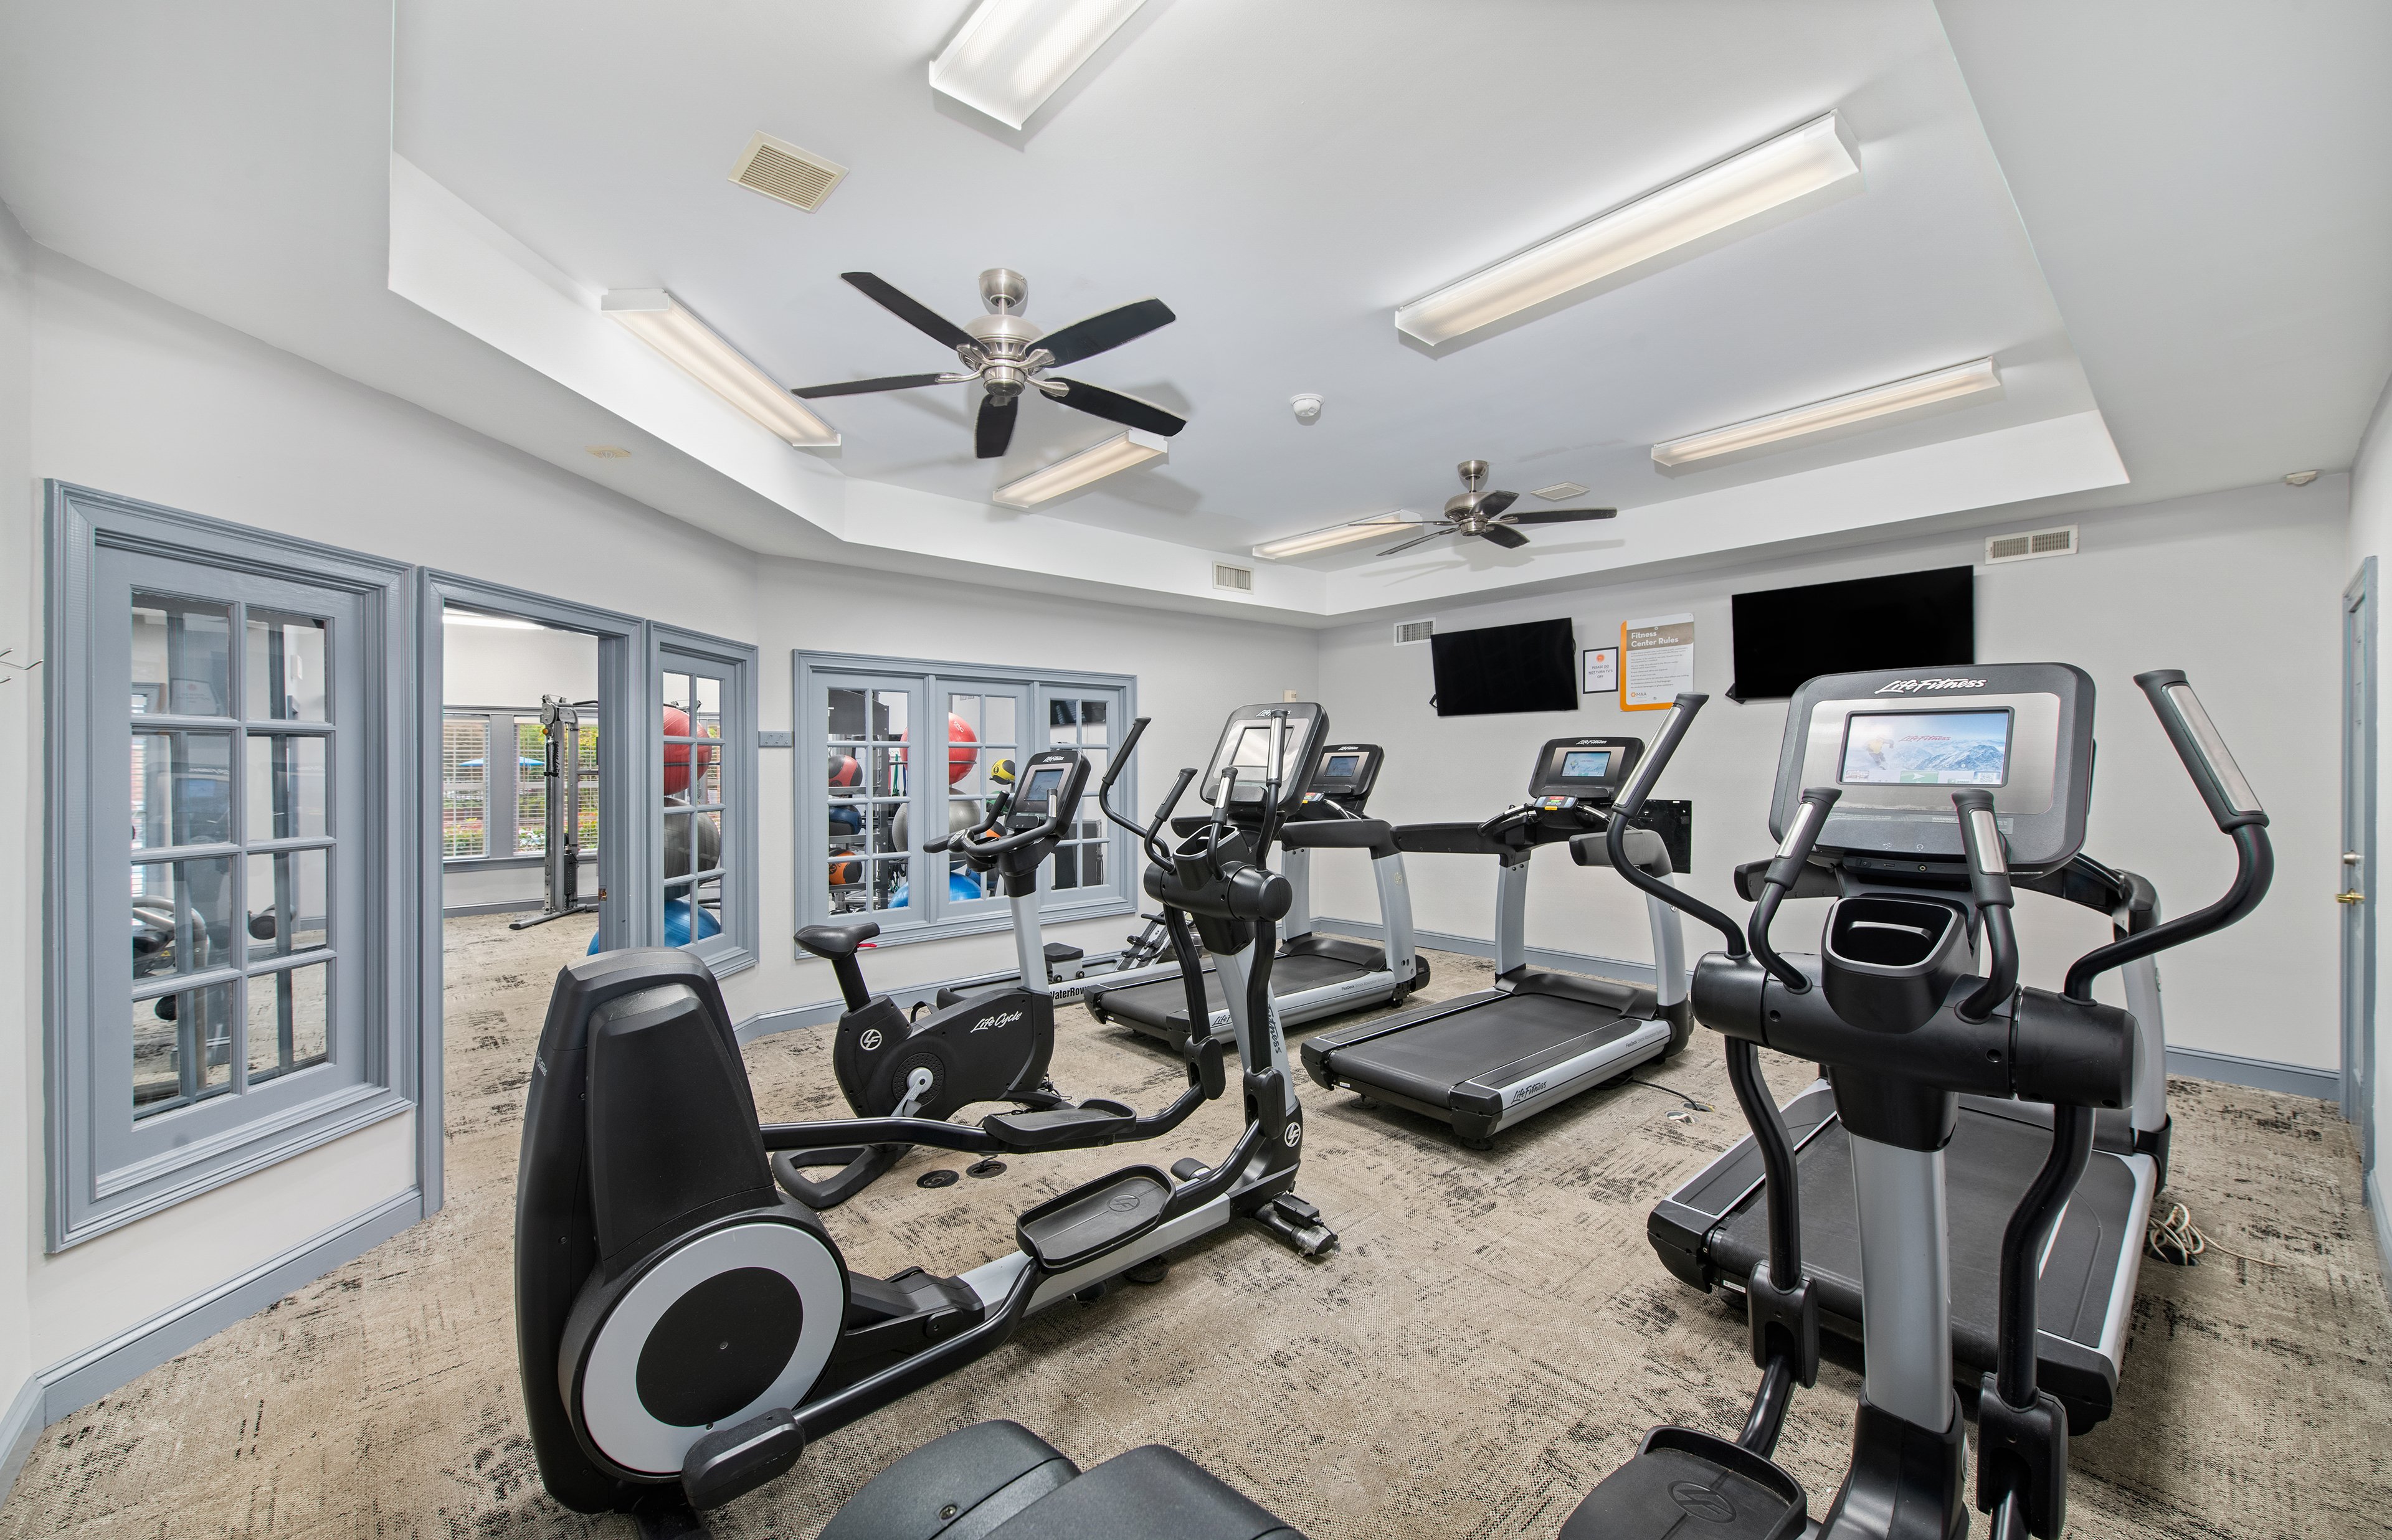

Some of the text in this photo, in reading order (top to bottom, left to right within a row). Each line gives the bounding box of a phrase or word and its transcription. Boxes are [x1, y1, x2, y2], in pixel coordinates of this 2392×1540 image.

[1631, 636, 1679, 648] Center Rules
[1050, 986, 1090, 1000] aterRow
